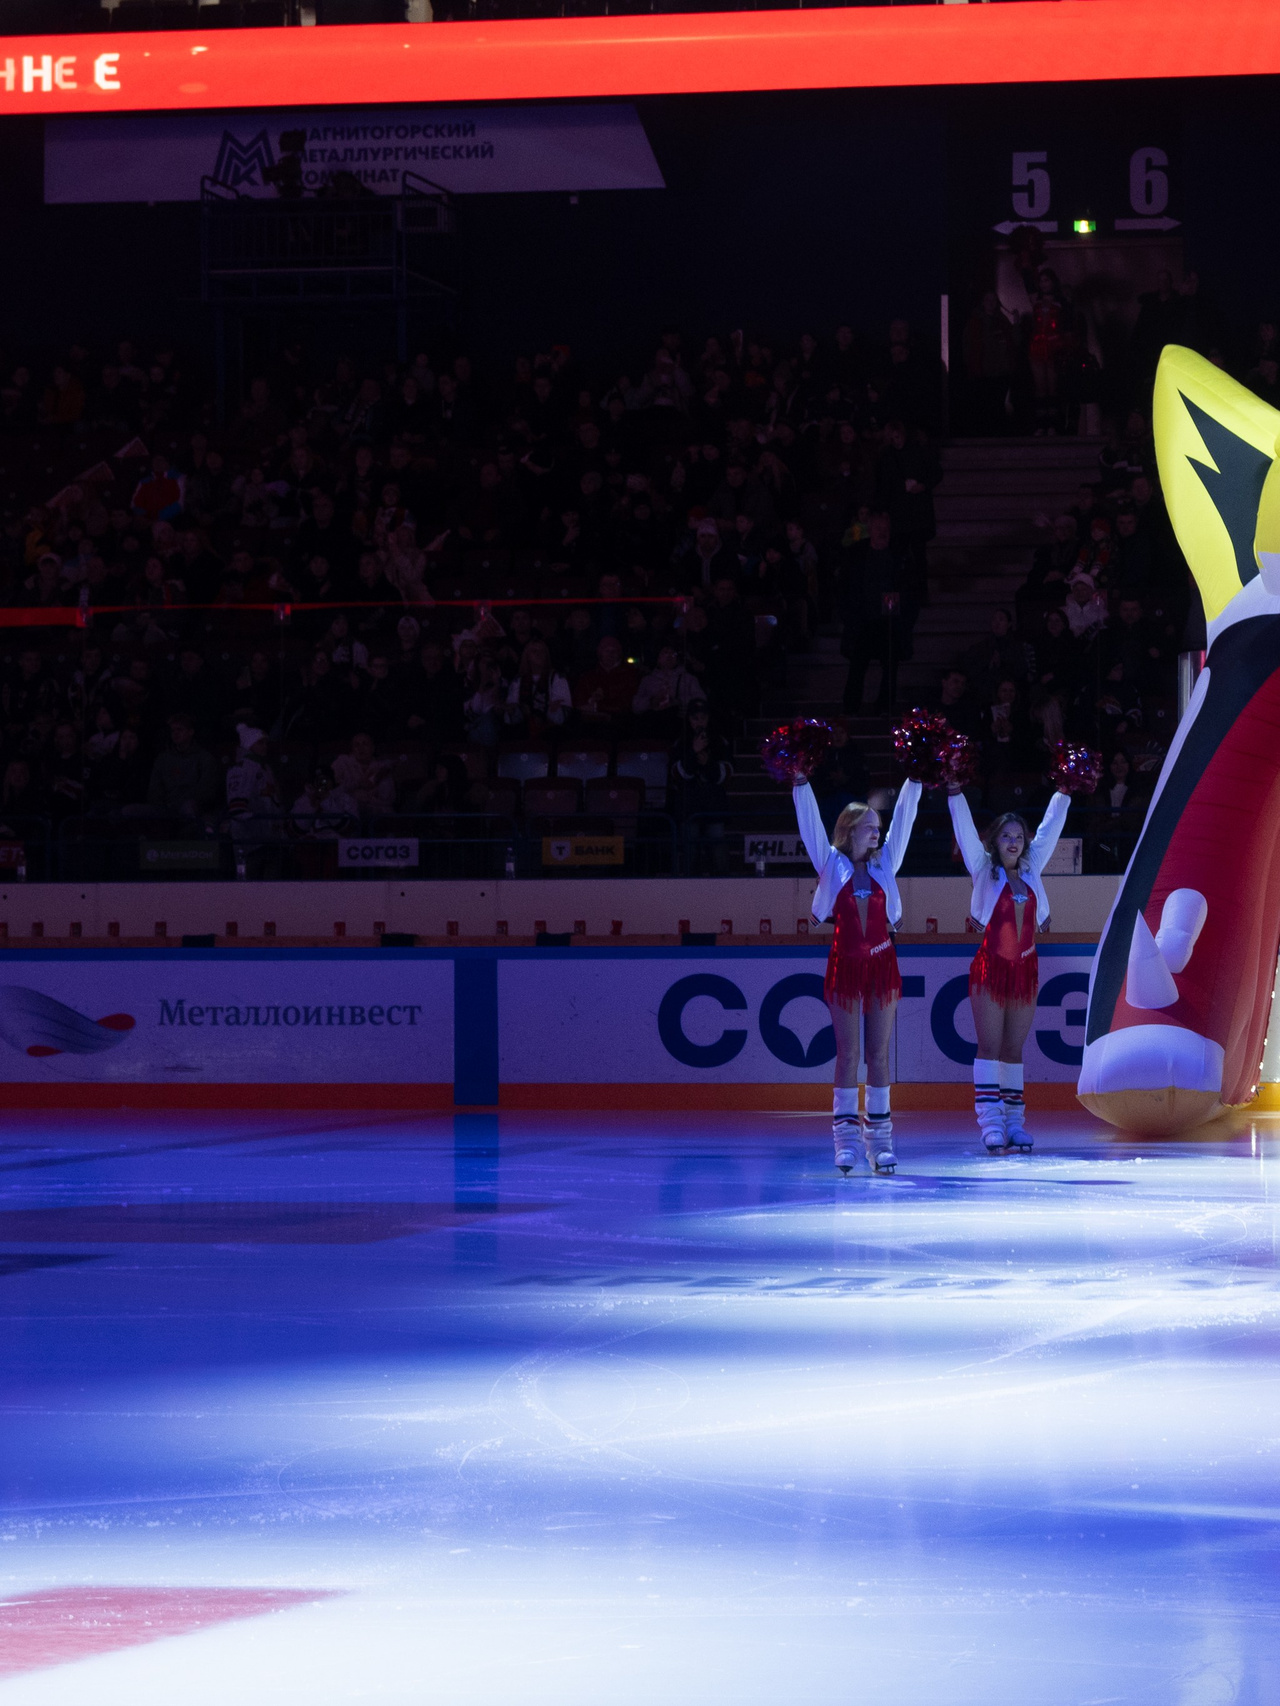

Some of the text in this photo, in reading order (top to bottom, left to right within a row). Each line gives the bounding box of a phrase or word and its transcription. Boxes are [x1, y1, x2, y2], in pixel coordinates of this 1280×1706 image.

[304, 120, 476, 142] АГНИТОГОРСКИЙ
[1012, 151, 1050, 218] 5
[1130, 146, 1168, 215] 6
[574, 845, 616, 856] БАНК
[158, 999, 423, 1027] Металлоинвест
